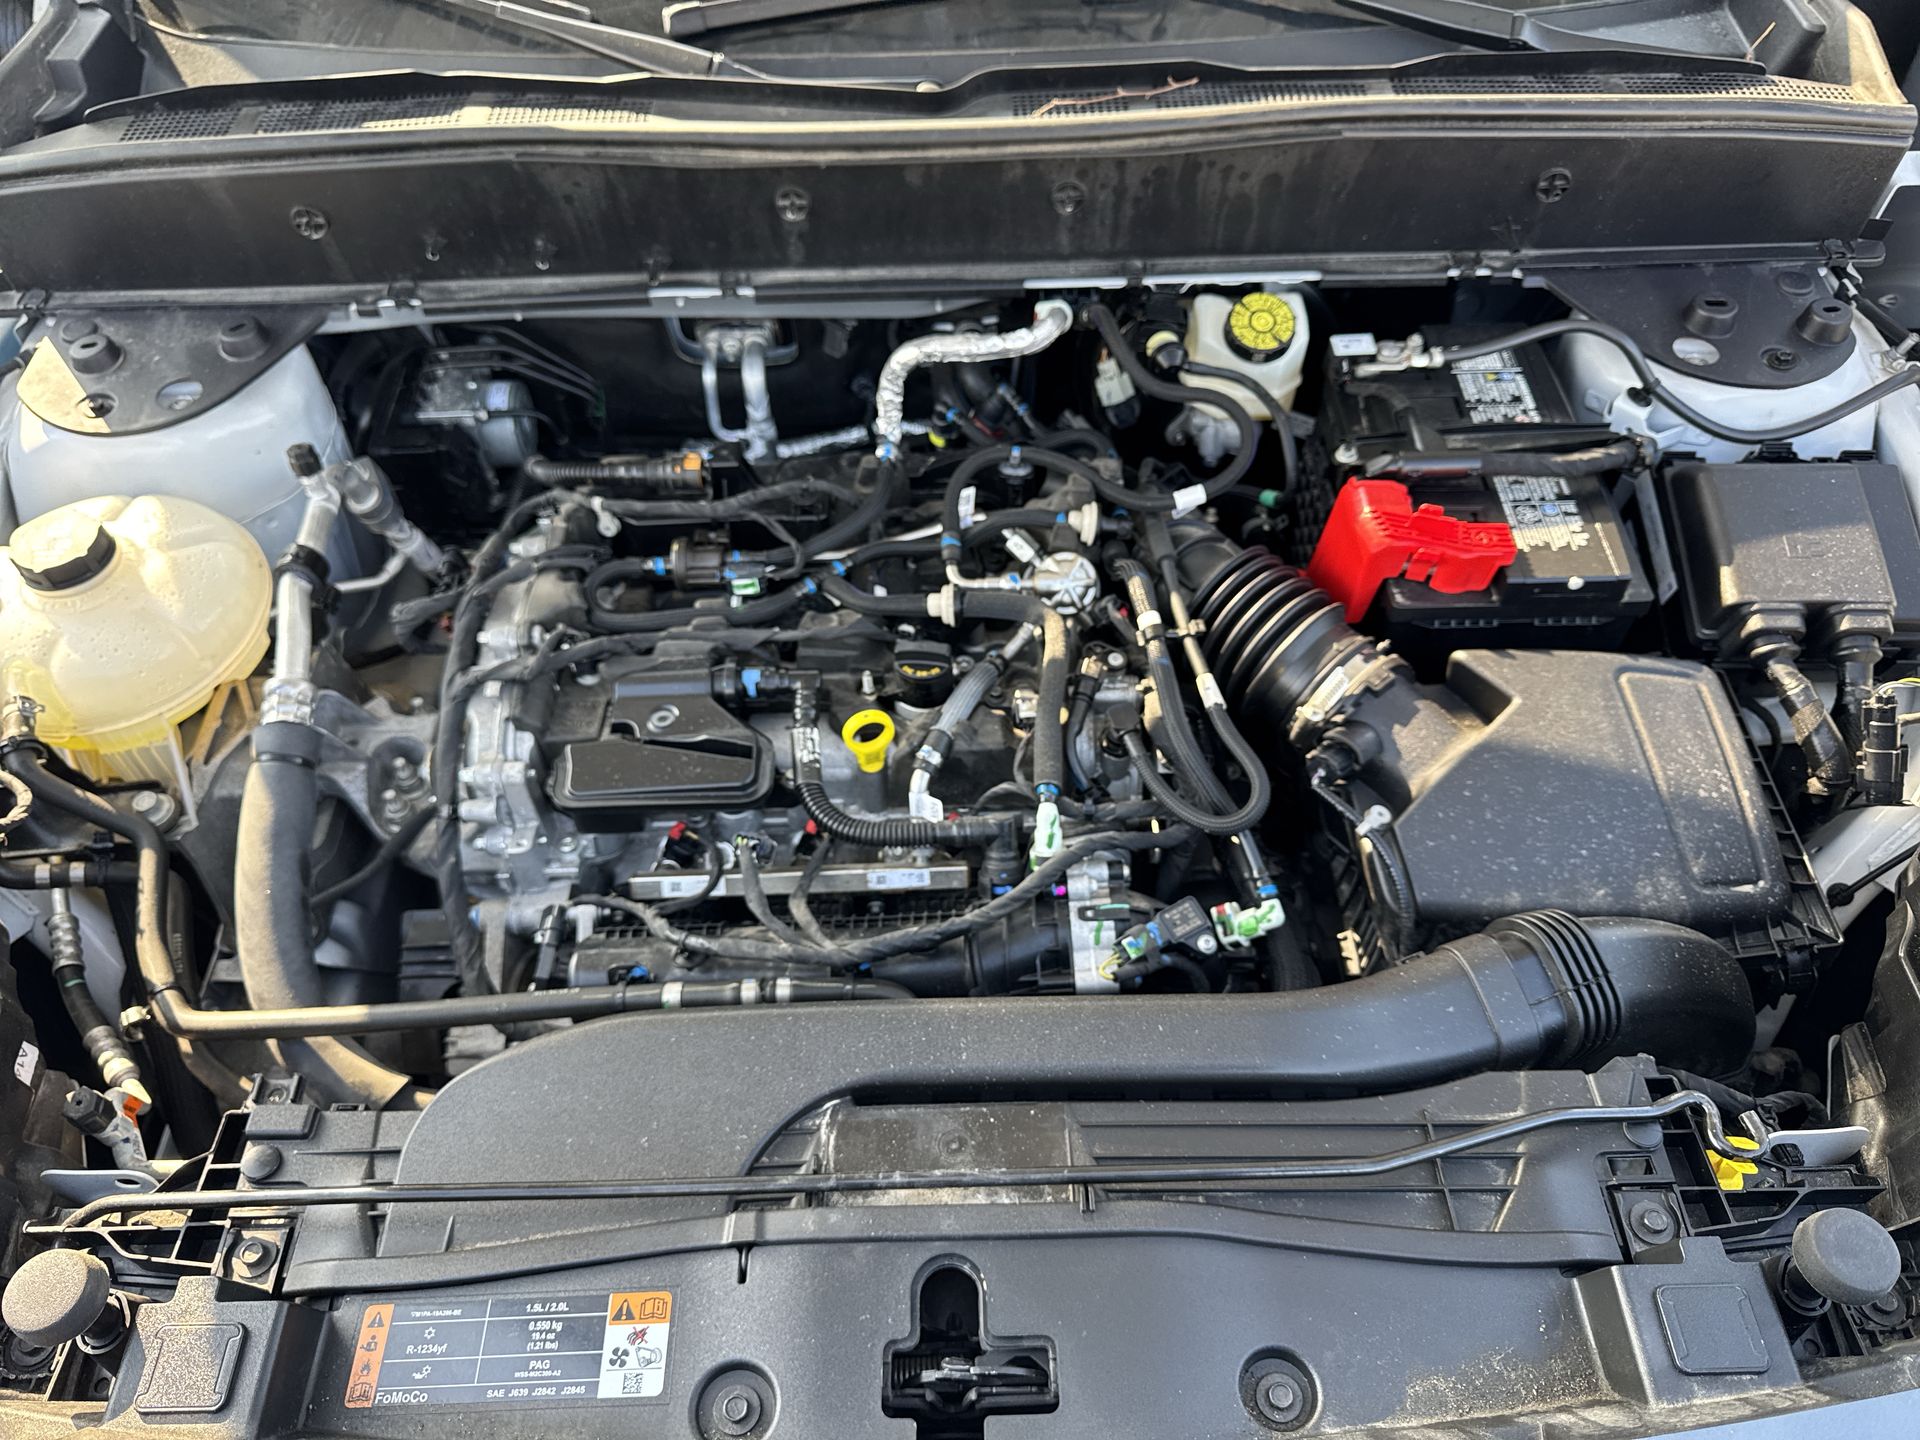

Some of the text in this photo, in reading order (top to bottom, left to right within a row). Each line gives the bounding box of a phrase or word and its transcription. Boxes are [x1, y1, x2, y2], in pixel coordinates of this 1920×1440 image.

[526, 1303, 544, 1312] 1.5L
[550, 1302, 569, 1311] 2.0L
[528, 1320, 563, 1332] 0.550 kg
[531, 1332, 546, 1340] 19.4
[406, 1344, 448, 1355] R-1234yf
[527, 1341, 559, 1351] (1.21 lbs)
[529, 1360, 551, 1370] PAG
[375, 1390, 429, 1404] FoMoCo
[486, 1386, 586, 1398] SAE J639 J2842 J2845
